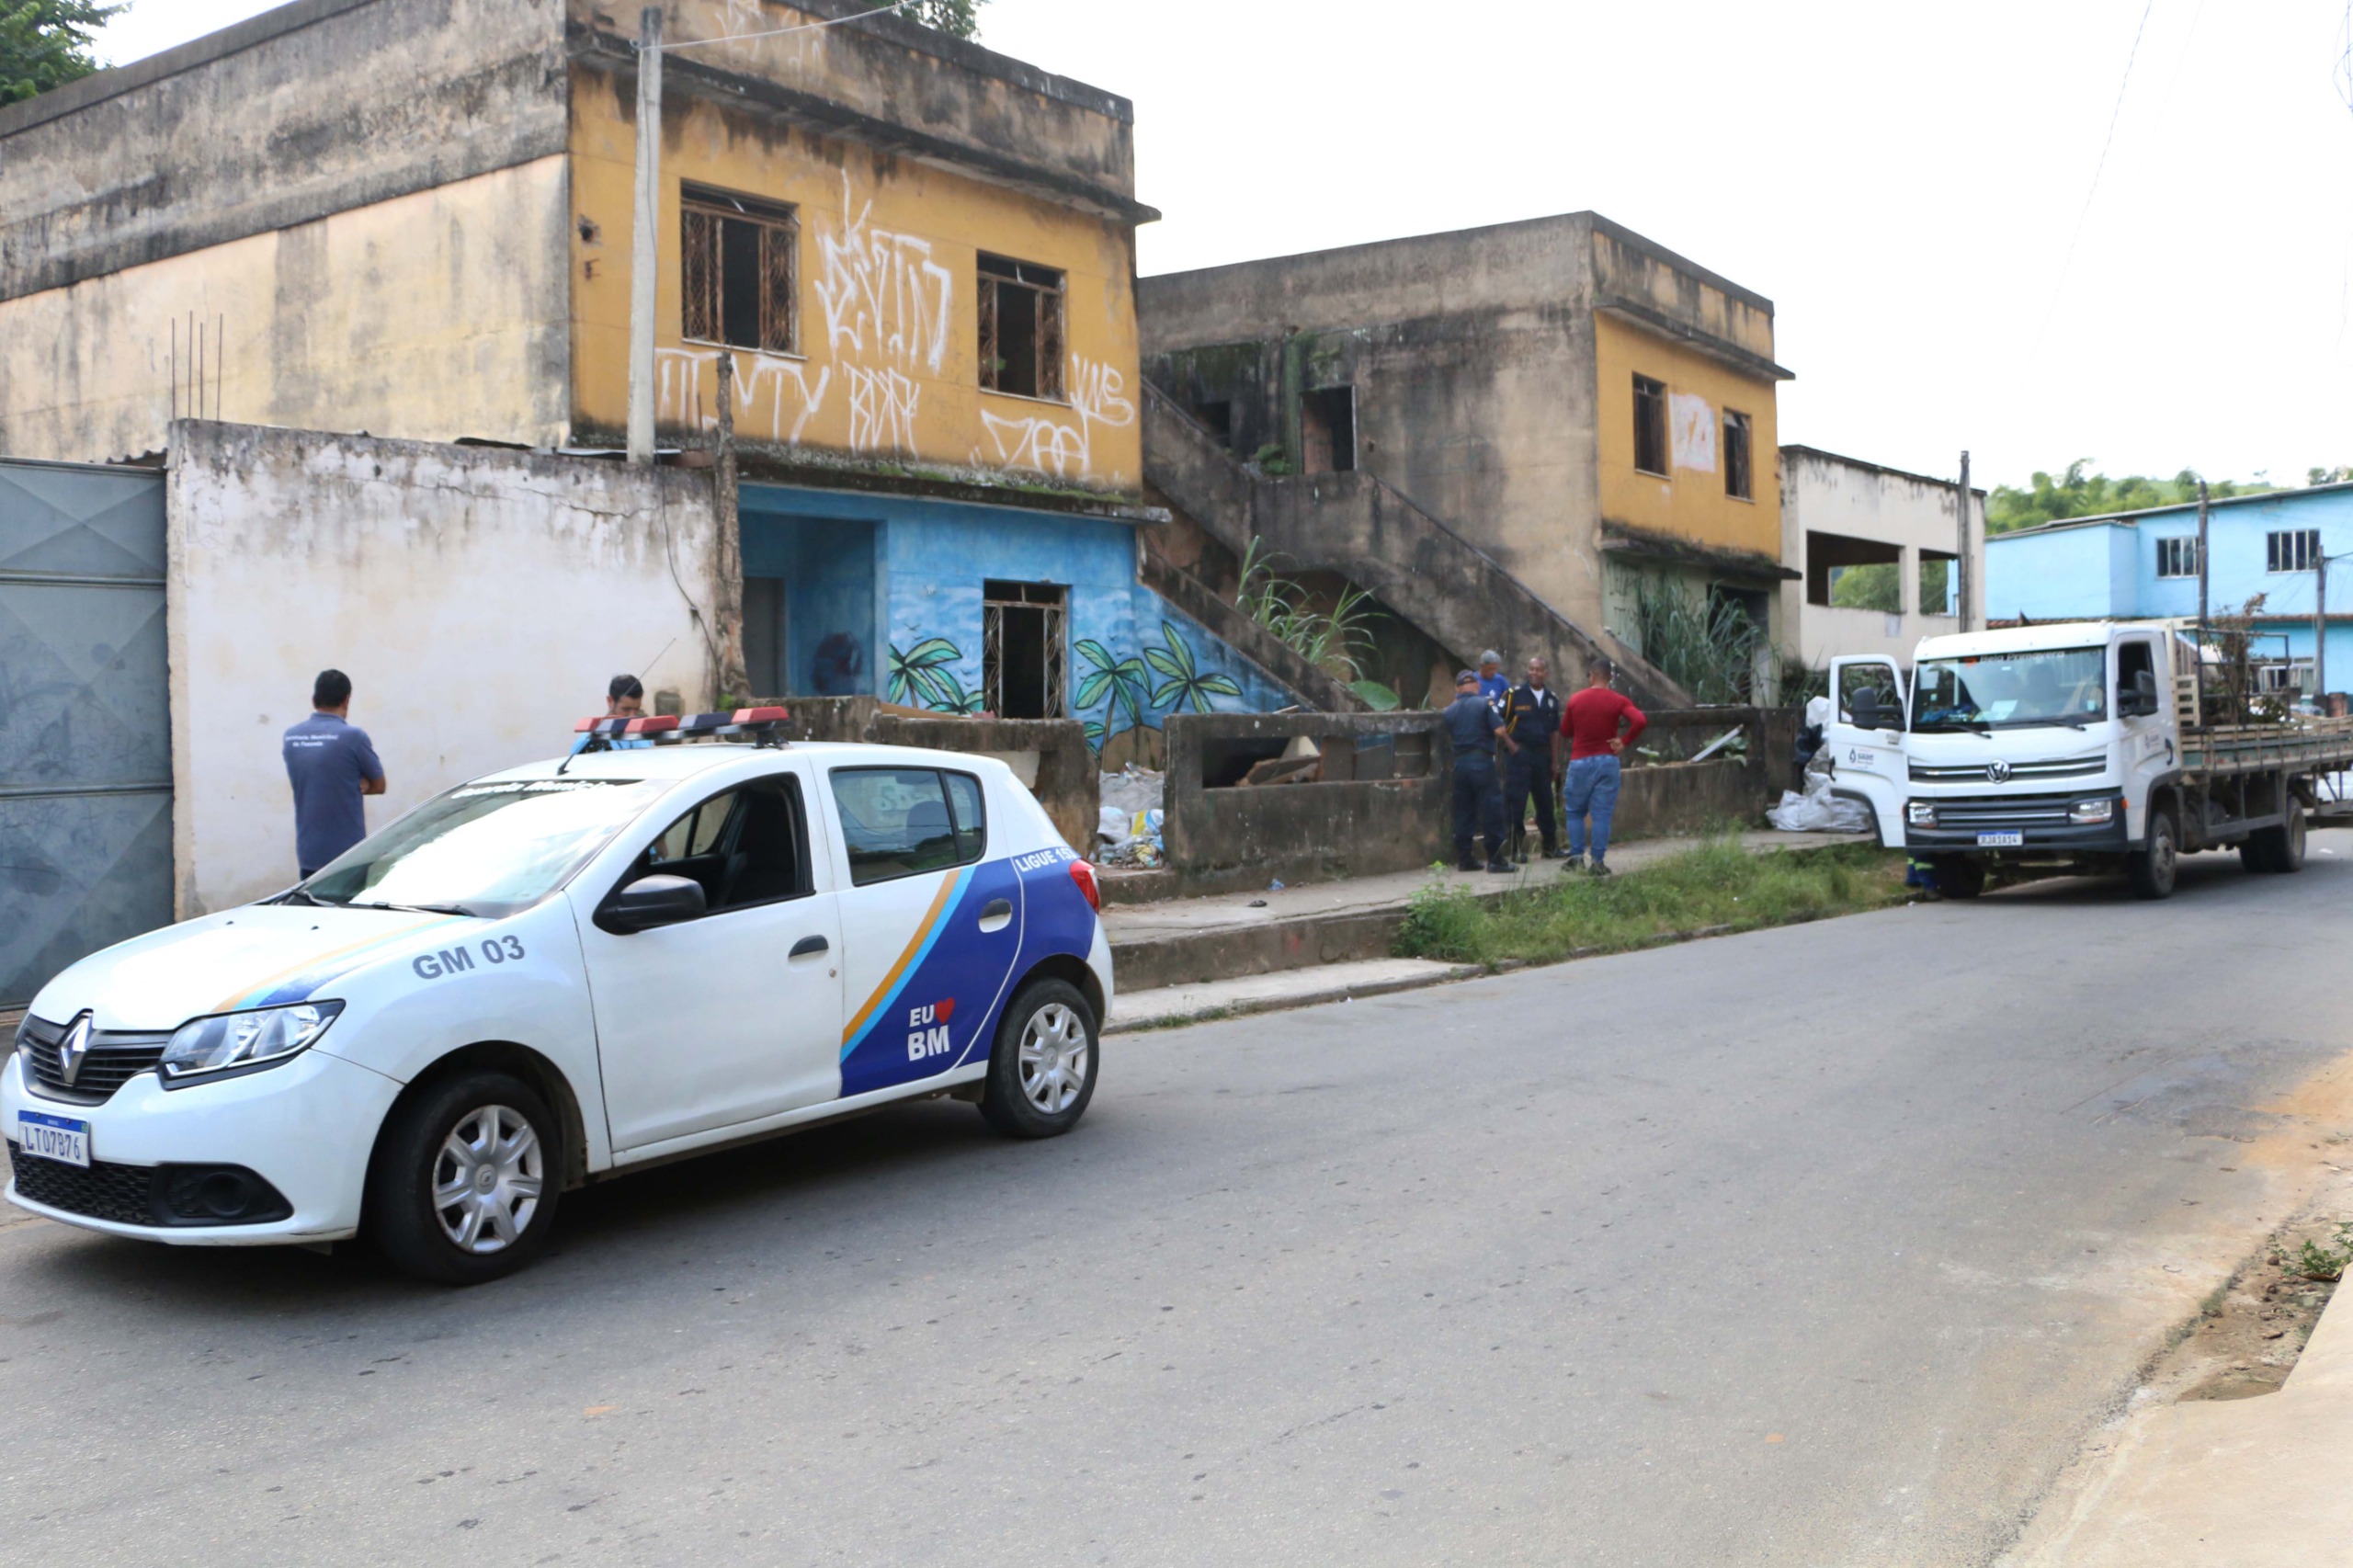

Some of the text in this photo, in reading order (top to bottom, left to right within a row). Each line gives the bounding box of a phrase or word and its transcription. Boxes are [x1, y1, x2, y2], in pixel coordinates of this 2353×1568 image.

[1015, 850, 1058, 872] LIGUE
[412, 935, 525, 980] GM 03
[909, 1004, 935, 1028] EU
[907, 1024, 950, 1062] BM
